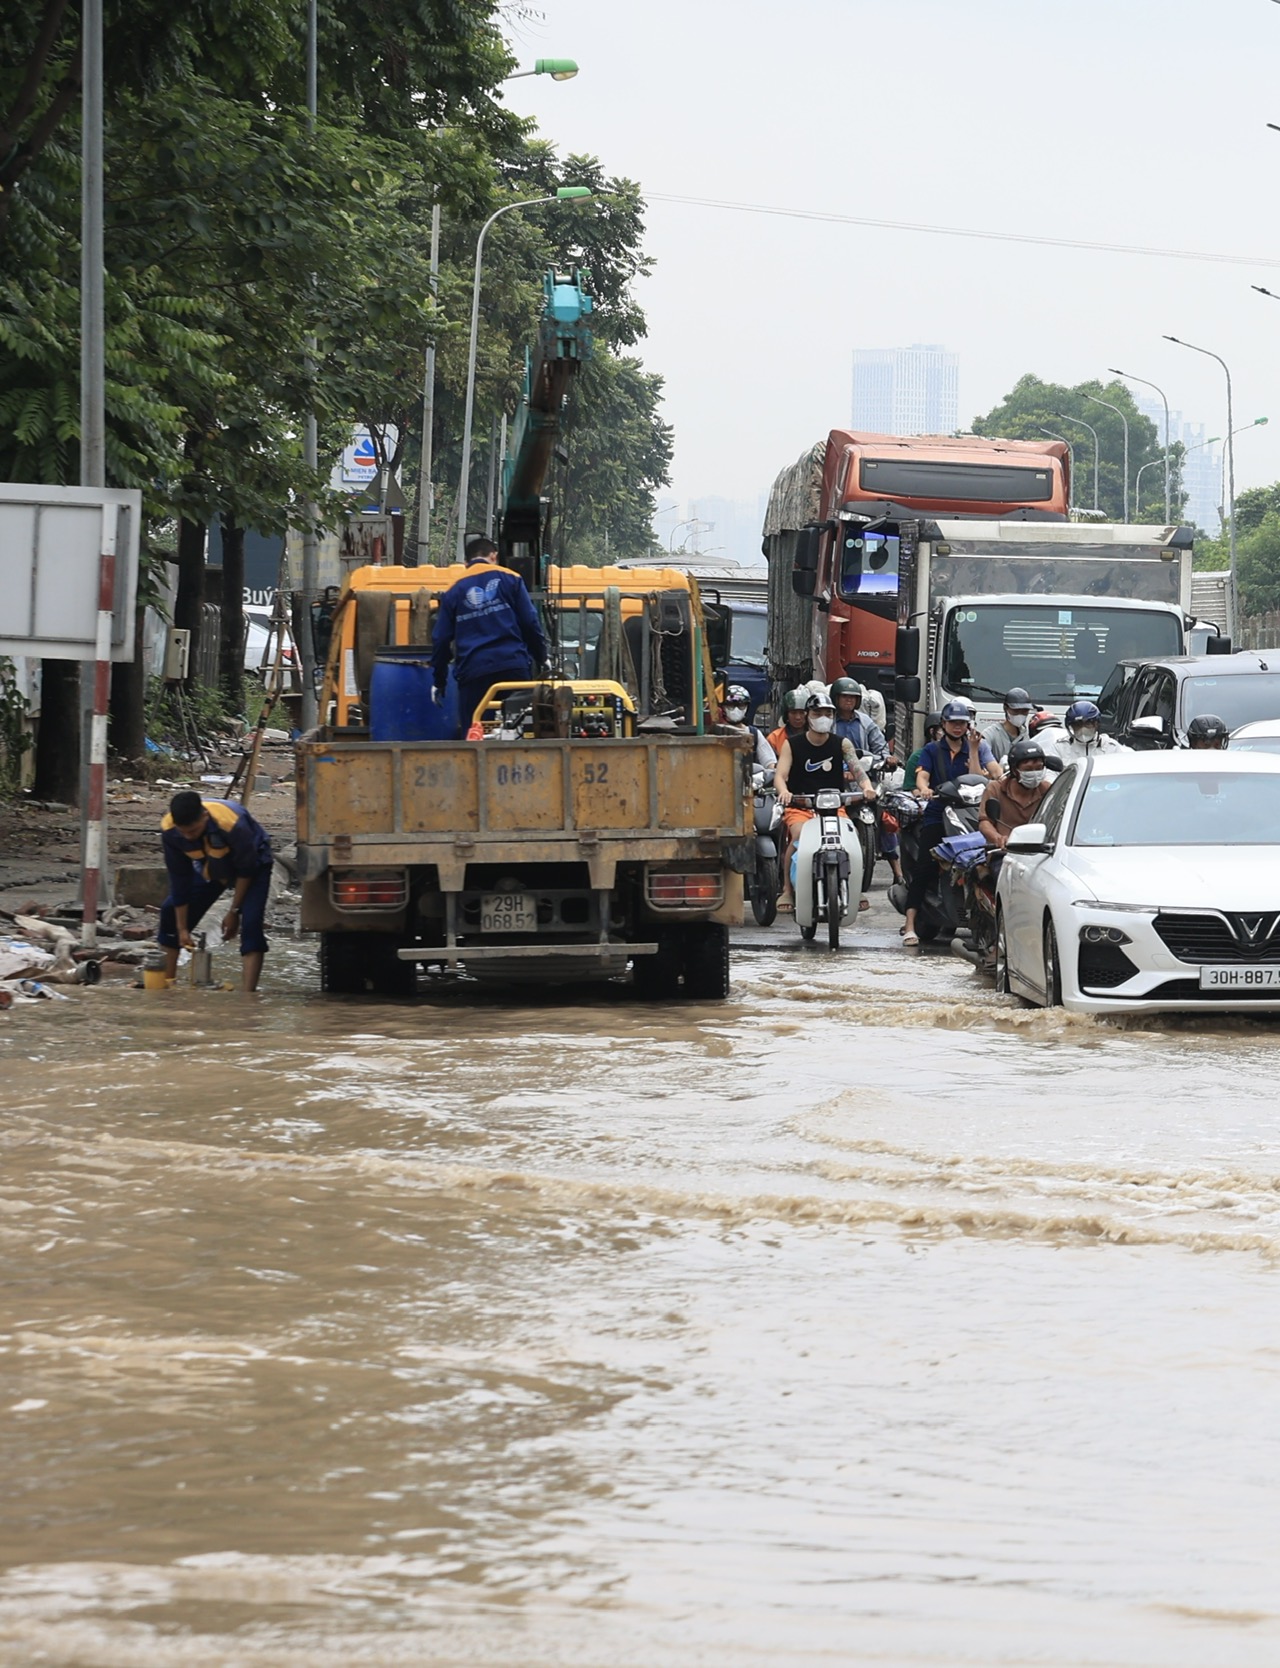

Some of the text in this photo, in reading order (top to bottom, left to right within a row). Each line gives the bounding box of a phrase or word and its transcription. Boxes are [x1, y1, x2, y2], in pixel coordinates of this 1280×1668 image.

[242, 586, 278, 606] Buý
[497, 764, 536, 786] 068
[583, 762, 609, 785] 52
[493, 895, 524, 912] 29H
